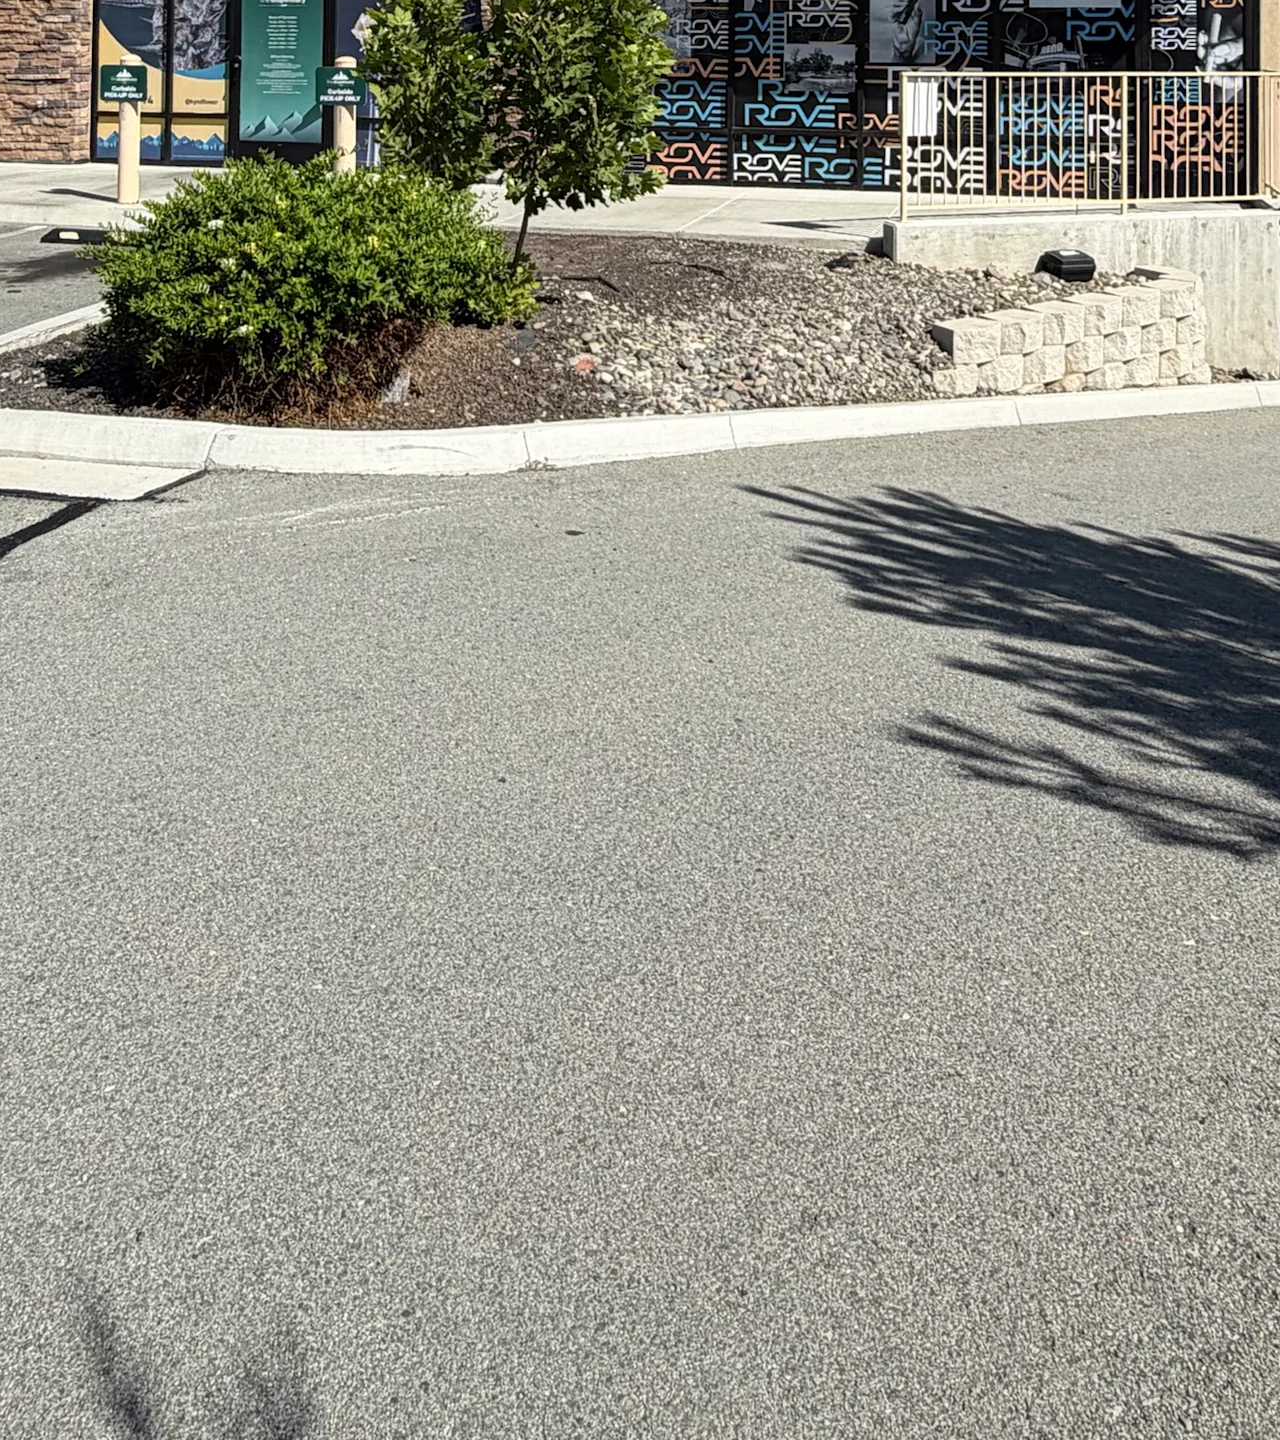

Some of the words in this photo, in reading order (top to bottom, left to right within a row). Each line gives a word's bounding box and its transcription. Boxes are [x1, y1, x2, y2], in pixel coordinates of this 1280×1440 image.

[1151, 4, 1197, 15] ROVE
[676, 20, 729, 34] ROVE
[734, 12, 785, 31] OVE
[788, 11, 850, 27] ROVE
[924, 20, 988, 36] ROVE
[1065, 21, 1136, 41] ROV
[1151, 27, 1197, 39] ROVE
[676, 35, 729, 50] ROVE
[734, 35, 785, 54] OVE
[924, 40, 988, 56] ROVE
[1151, 38, 1197, 50] ROVE
[666, 58, 729, 78] OVE
[734, 57, 781, 78] OVE
[652, 79, 726, 100] ROVE
[744, 103, 836, 128] ROVE
[838, 113, 900, 131] ROVE
[733, 153, 802, 172] ROVE
